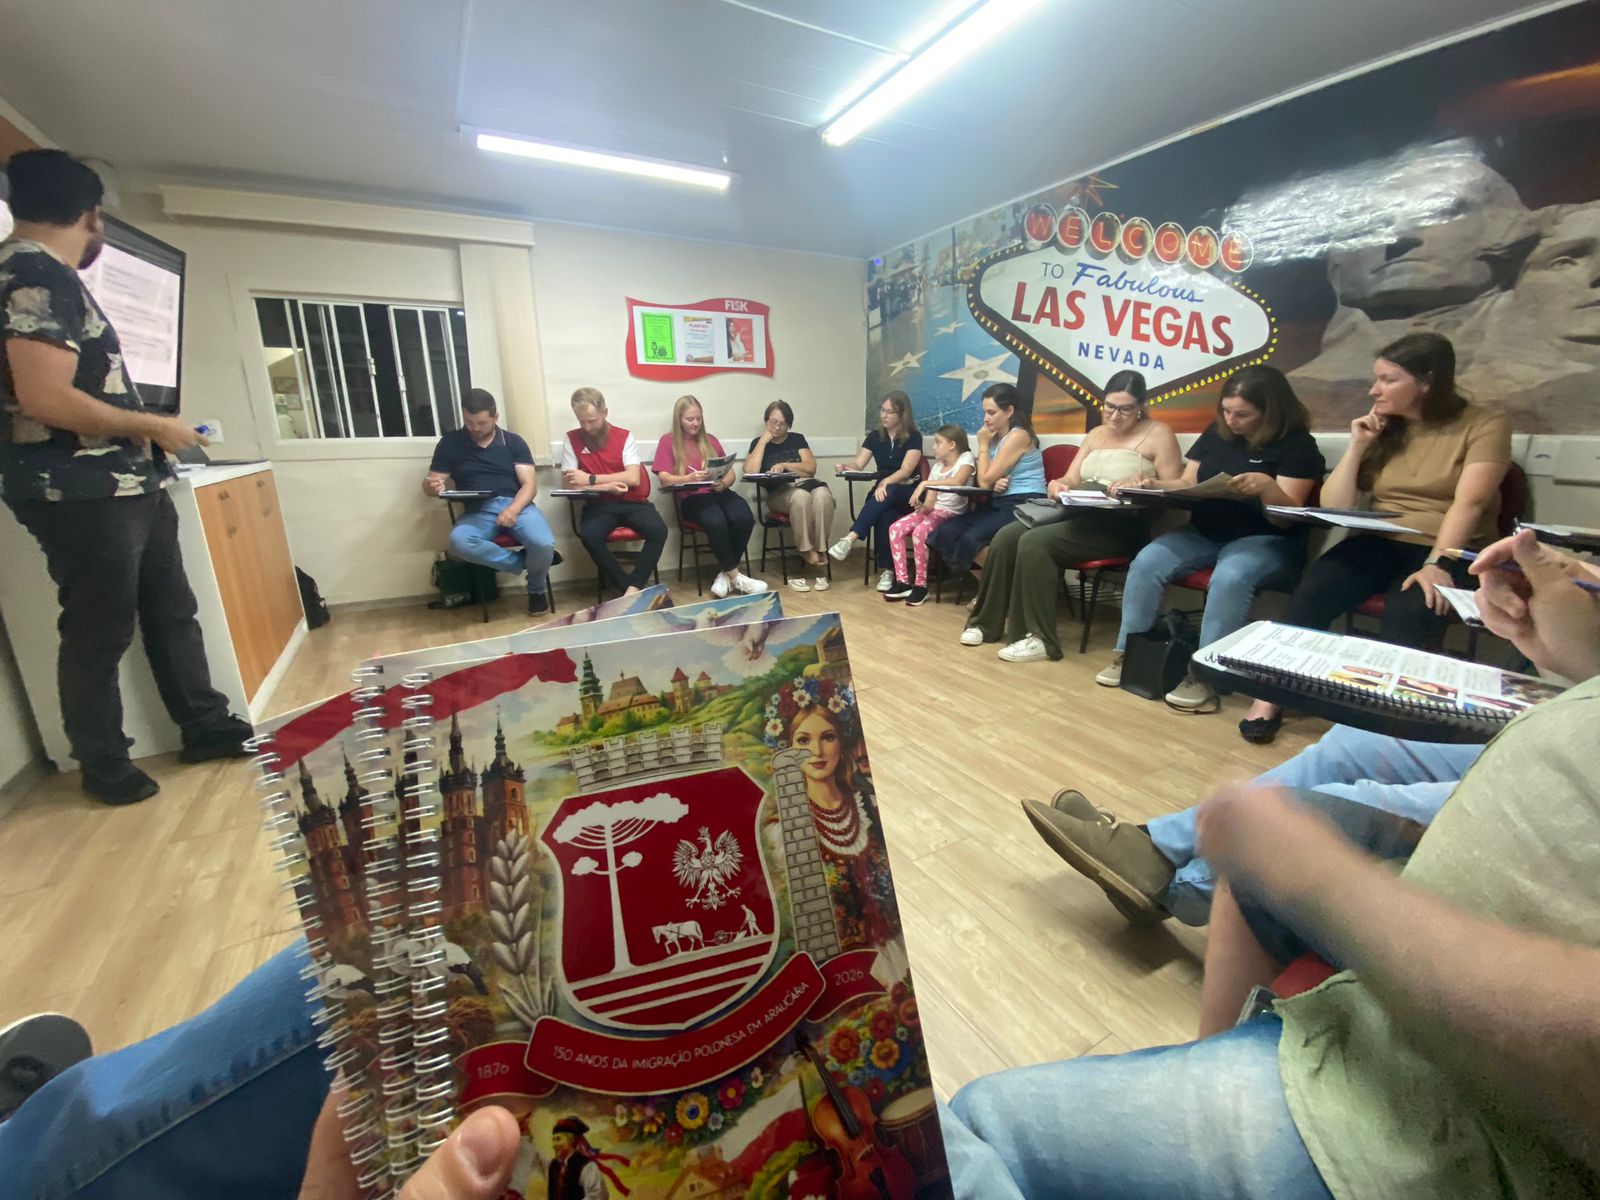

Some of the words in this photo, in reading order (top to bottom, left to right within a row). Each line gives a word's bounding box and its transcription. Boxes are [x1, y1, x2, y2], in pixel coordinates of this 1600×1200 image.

[1027, 207, 1251, 268] WELCOME
[1041, 261, 1065, 280] TO
[1071, 262, 1205, 303] Fabulous
[724, 299, 749, 312] FISK
[1010, 281, 1086, 330] LAS
[1102, 294, 1234, 357] VEGAS
[1077, 341, 1165, 370] NEVADA
[834, 969, 864, 986] 2026
[552, 1045, 574, 1061] 150
[575, 1053, 609, 1069] ANOS
[611, 1057, 628, 1070] DA
[632, 1048, 692, 1070] IMIGRAÇÃO
[694, 1029, 747, 1058] POLONESA
[747, 1019, 763, 1035] EM
[763, 981, 810, 1026] ARAUCÁRIA
[477, 1061, 511, 1079] 1876
